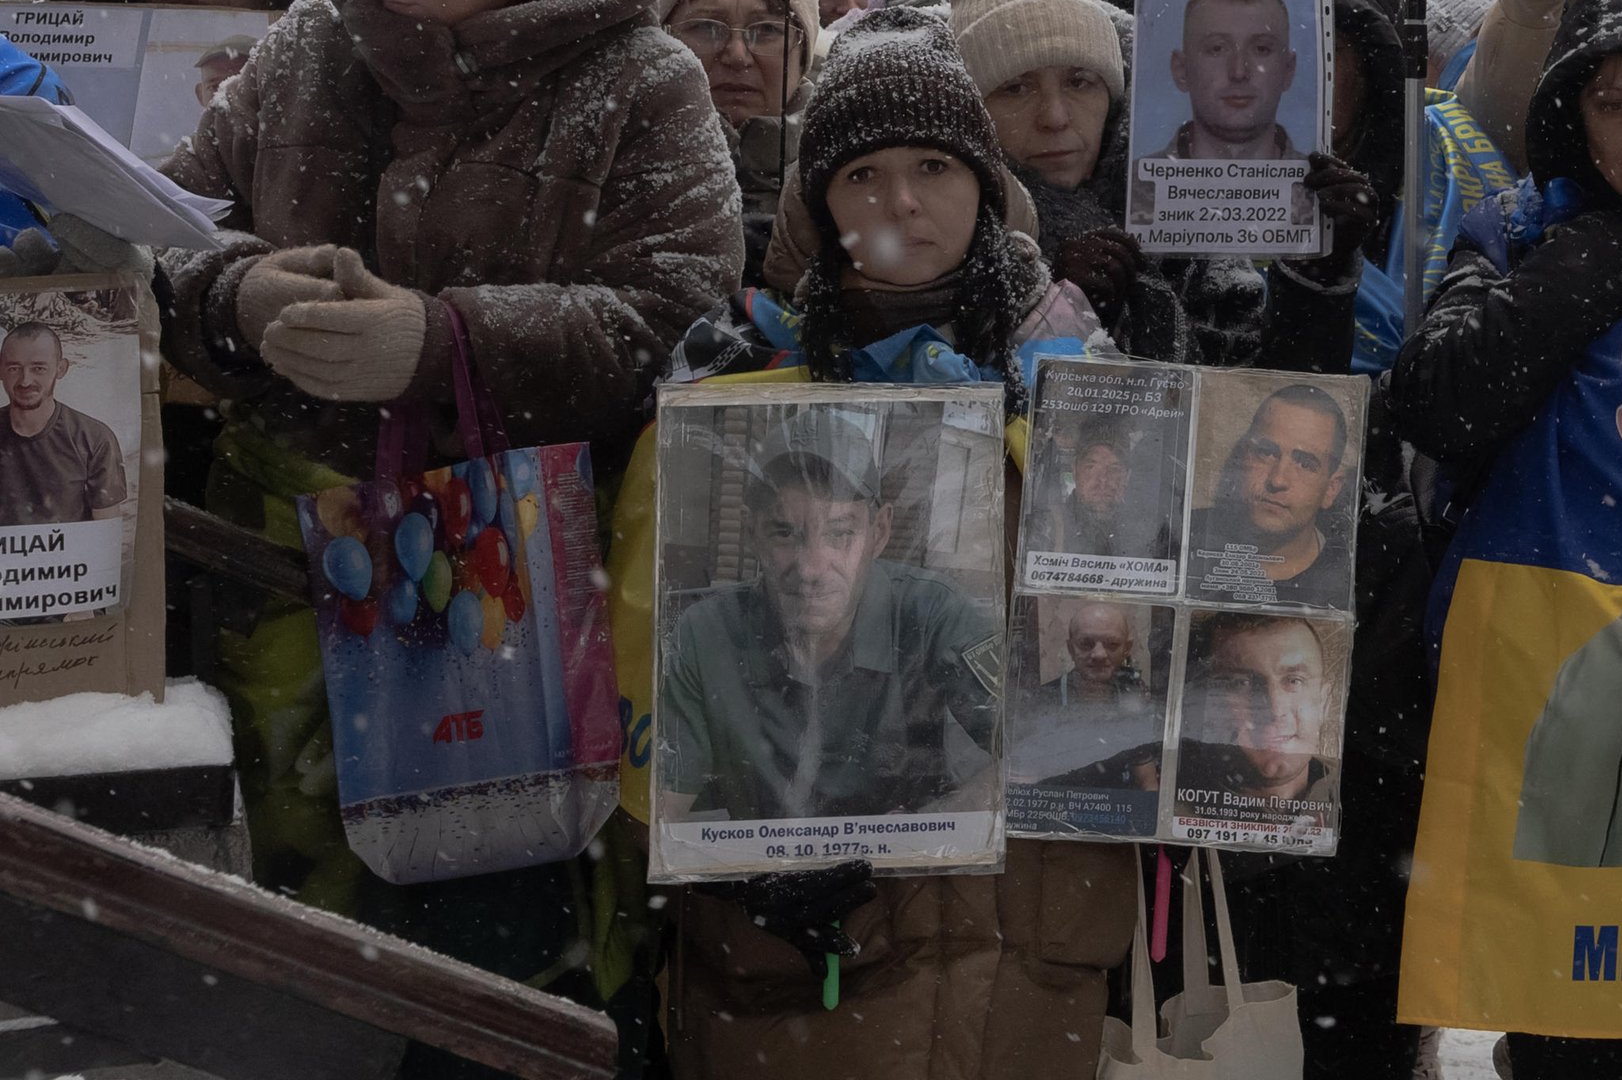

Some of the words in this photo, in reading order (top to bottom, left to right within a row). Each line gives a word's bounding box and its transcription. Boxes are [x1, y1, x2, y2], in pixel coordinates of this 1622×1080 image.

[15, 10, 84, 27] ГРИЦАЙ
[1, 31, 95, 46] Володимир
[29, 52, 112, 65] имирович
[1143, 162, 1224, 180] Черненко
[1227, 163, 1305, 178] Станіслав
[1167, 185, 1280, 200] Вячеславович
[1158, 210, 1194, 221] зник
[1199, 207, 1287, 221] 27.03.2022
[1149, 229, 1234, 246] Маріуполь
[1262, 229, 1312, 244] ОБМП
[1045, 369, 1096, 382] Курська
[1099, 374, 1124, 386] обл.
[1126, 378, 1147, 387] н.п.
[1067, 386, 1130, 400] 20.01.2025
[1131, 393, 1142, 403] р.
[1041, 399, 1089, 411] 253ошб
[1091, 403, 1112, 413] 129
[1115, 404, 1139, 416] ТРО
[1034, 555, 1068, 567] Хоміч
[1071, 557, 1117, 570] Василь
[1119, 561, 1169, 572] «ХОМА»
[0, 562, 88, 585] димир
[1031, 570, 1104, 584] 0674784668
[1111, 577, 1167, 588] дружина
[0, 584, 117, 612] мирович
[432, 709, 484, 744] АТБ
[1033, 789, 1064, 799] Руслан
[1066, 790, 1109, 800] Петрович
[1177, 788, 1220, 803] КОГУТ
[1223, 792, 1265, 807] Вадим
[1270, 796, 1332, 812] Петрович
[1006, 798, 1048, 808] 2.02.1977
[1083, 803, 1111, 812] А7400
[1116, 804, 1132, 812] 115
[1195, 806, 1238, 817] 31.05.1993
[1240, 811, 1259, 819] року
[701, 826, 754, 843] Кусков
[758, 824, 839, 839] Олександр
[1007, 822, 1037, 830] ужина
[1178, 818, 1228, 829] БЕЗВІСТИ
[1230, 821, 1281, 833] ЗНИКЛИЙ:
[1187, 828, 1210, 839] 097
[1215, 830, 1237, 841] 191
[766, 845, 789, 858] 08.
[794, 843, 817, 857] 10.
[878, 844, 891, 854] н.
